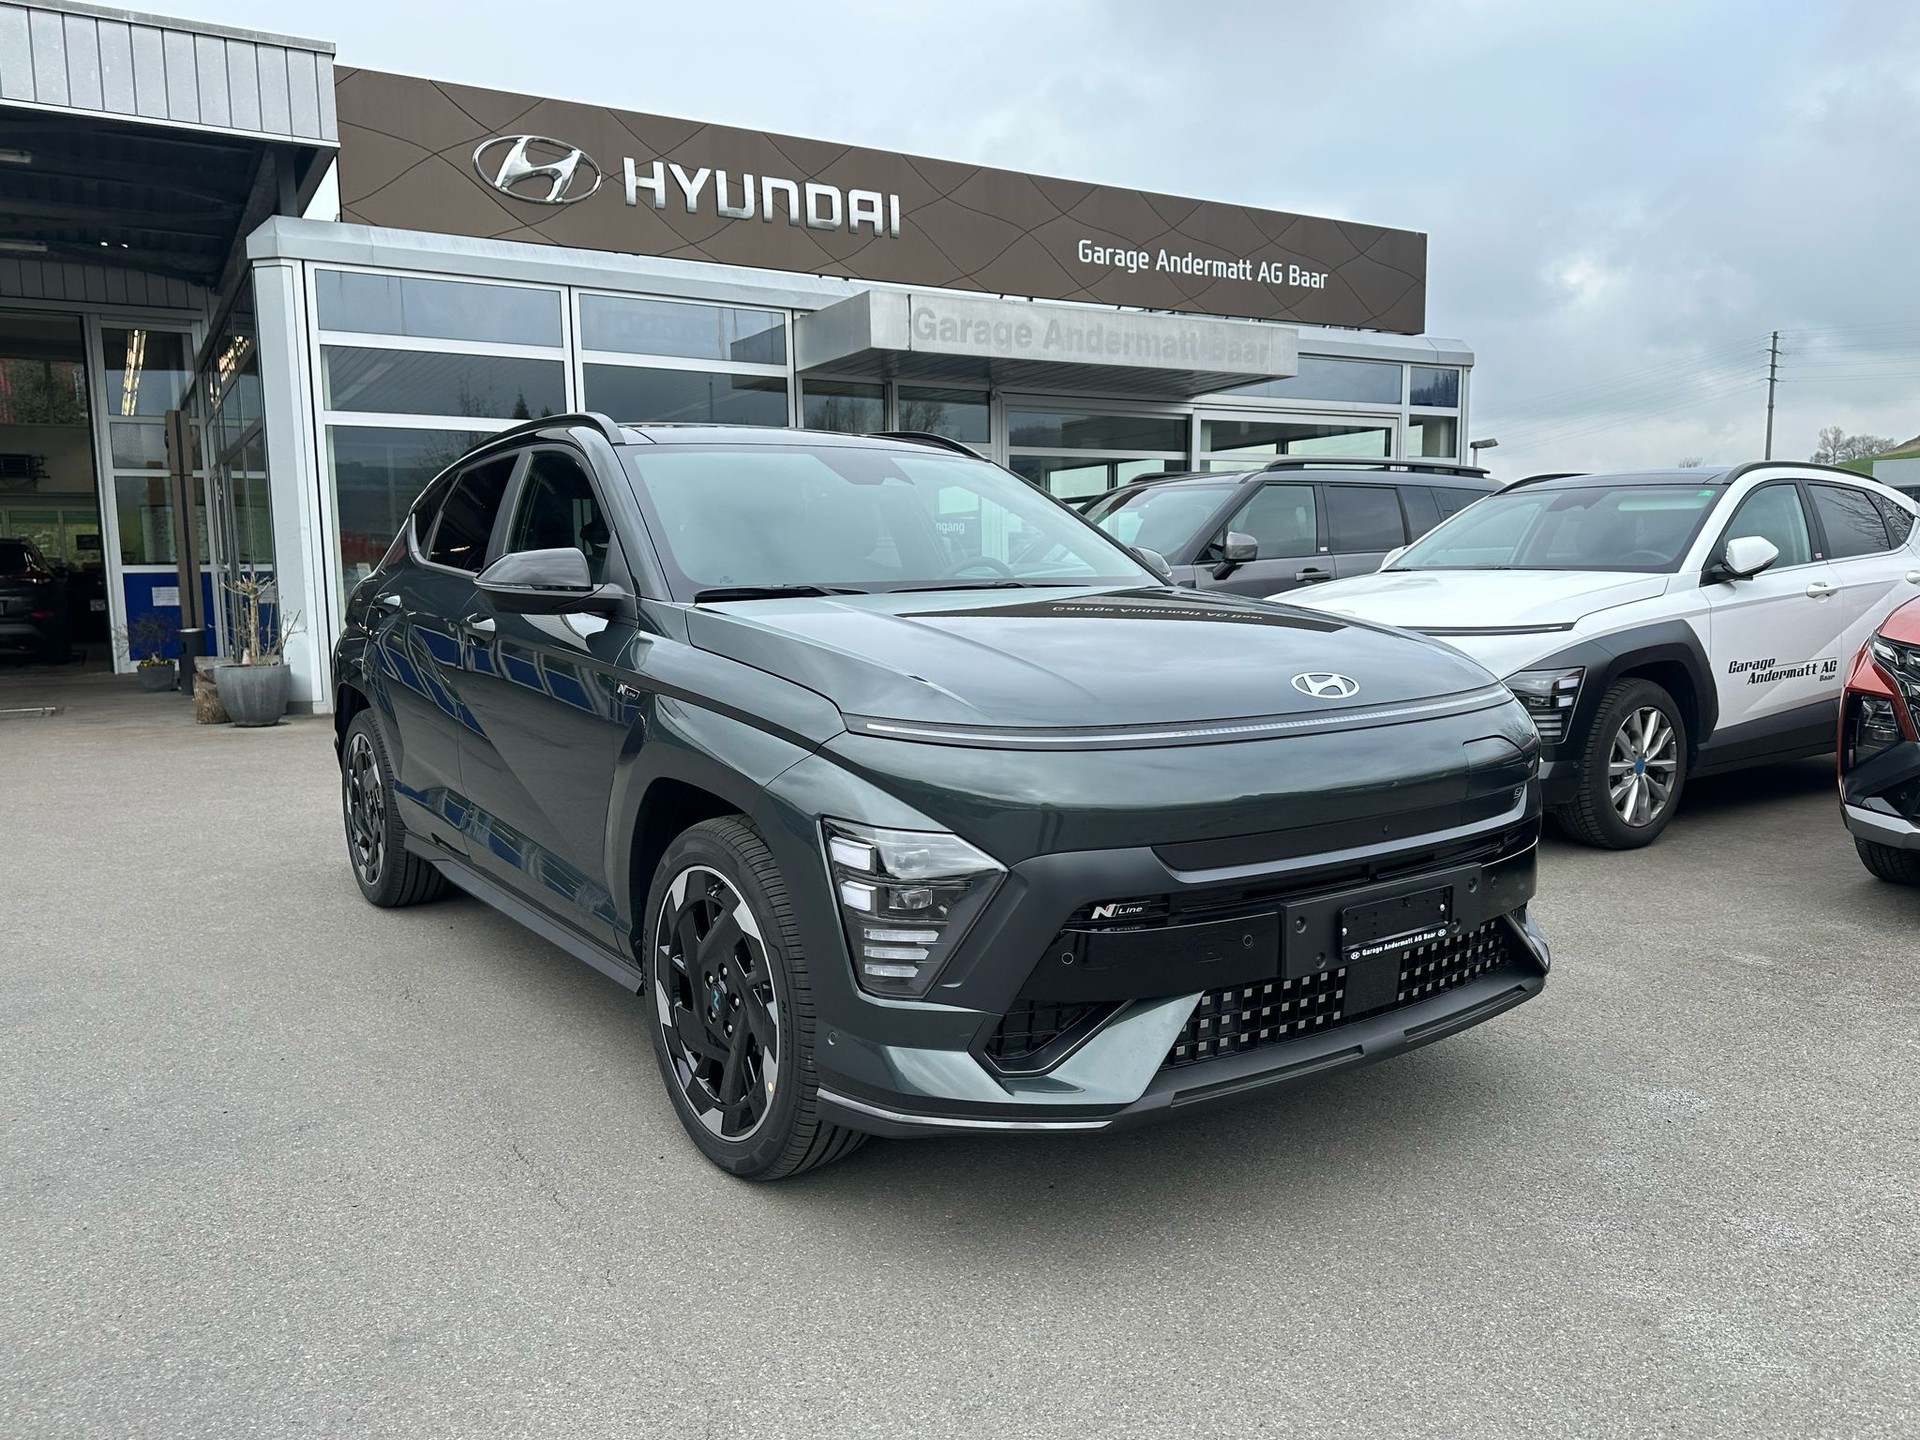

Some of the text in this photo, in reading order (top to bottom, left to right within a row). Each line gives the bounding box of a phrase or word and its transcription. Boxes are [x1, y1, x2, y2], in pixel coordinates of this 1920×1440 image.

[623, 157, 900, 239] HYUNDAI
[1078, 239, 1329, 289] Garage Andermatt AG Baar
[912, 306, 1033, 350] Garage
[1043, 319, 1200, 361] Andermatt
[935, 522, 965, 534] ngang
[1728, 658, 1776, 674] Garage
[1747, 660, 1838, 685] Andermatt AG
[1090, 903, 1118, 920] N
[1362, 932, 1437, 957] Garage Andermatt AG Baar
